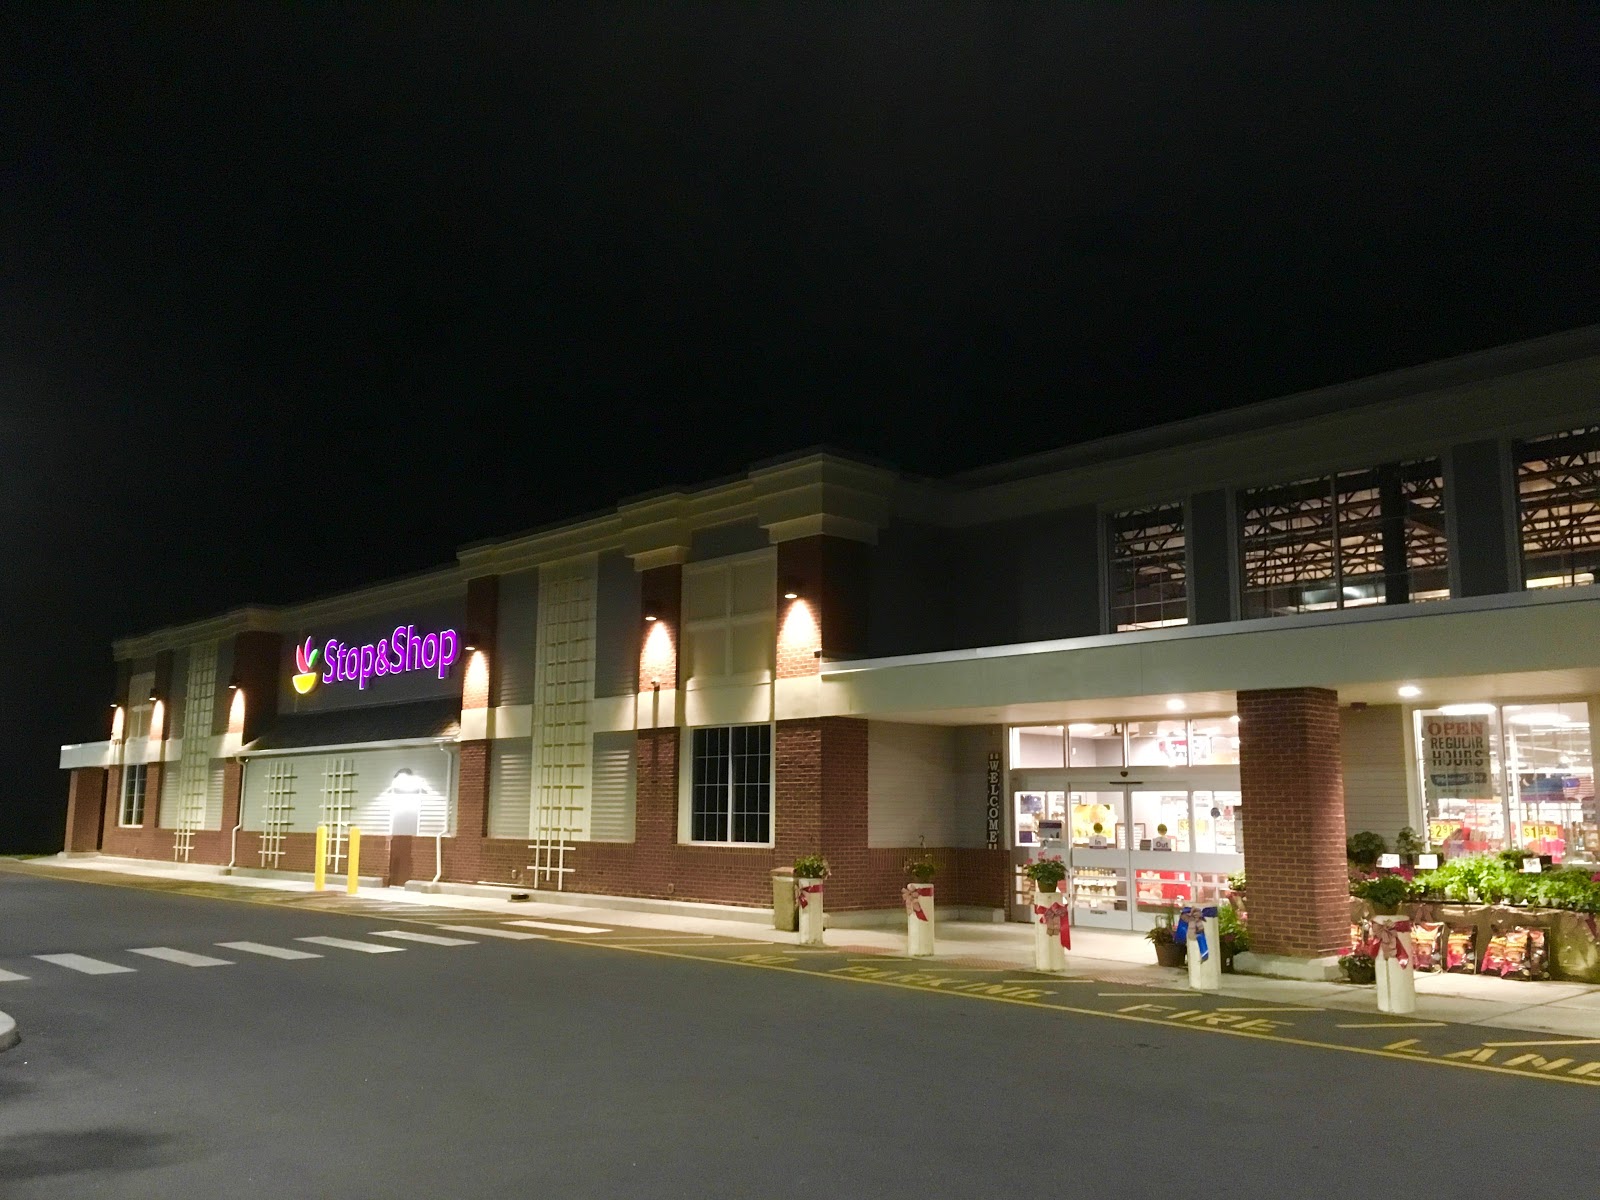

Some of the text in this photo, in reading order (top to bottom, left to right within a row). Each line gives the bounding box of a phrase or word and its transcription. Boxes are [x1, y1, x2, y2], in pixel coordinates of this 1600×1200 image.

[322, 624, 458, 691] Stop&Shop
[1428, 722, 1484, 736] OPEN
[1431, 736, 1483, 749] REGULAR
[1432, 750, 1484, 767] HOURS
[988, 760, 1000, 843] WELCOME
[1094, 838, 1102, 846] In
[1154, 840, 1169, 849] Out
[828, 965, 1059, 1000] PARKING
[1116, 1003, 1296, 1032] FIRE
